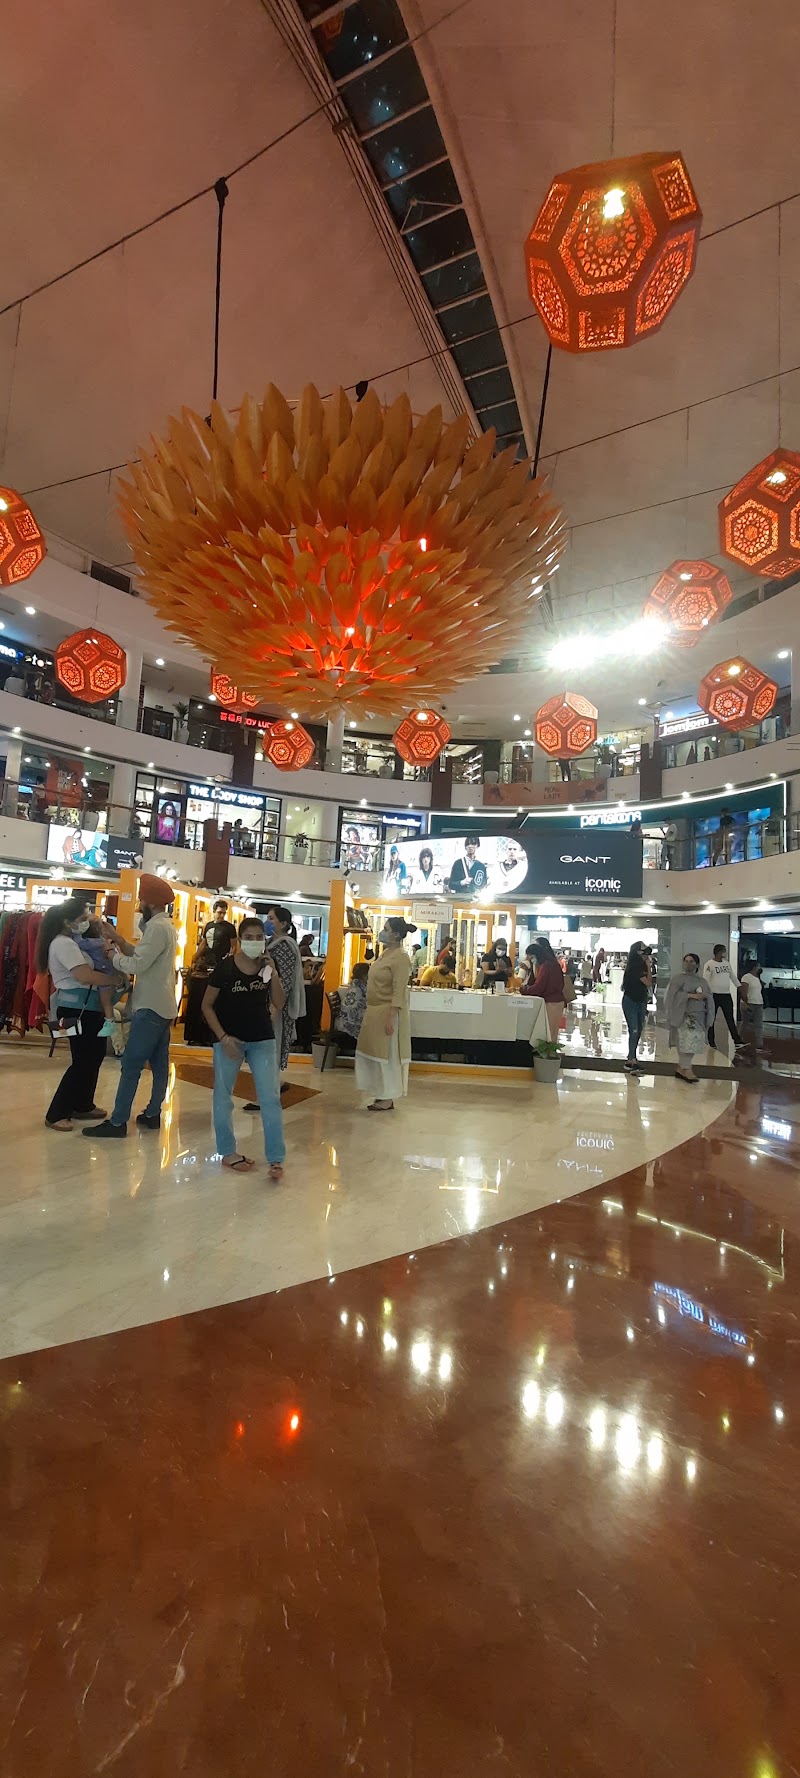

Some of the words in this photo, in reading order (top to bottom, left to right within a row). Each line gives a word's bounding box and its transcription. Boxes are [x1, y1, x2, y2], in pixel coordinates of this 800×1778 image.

[189, 784, 210, 798] THE
[238, 794, 264, 806] SHOP
[559, 855, 611, 864] GANT
[585, 876, 621, 889] iconic
